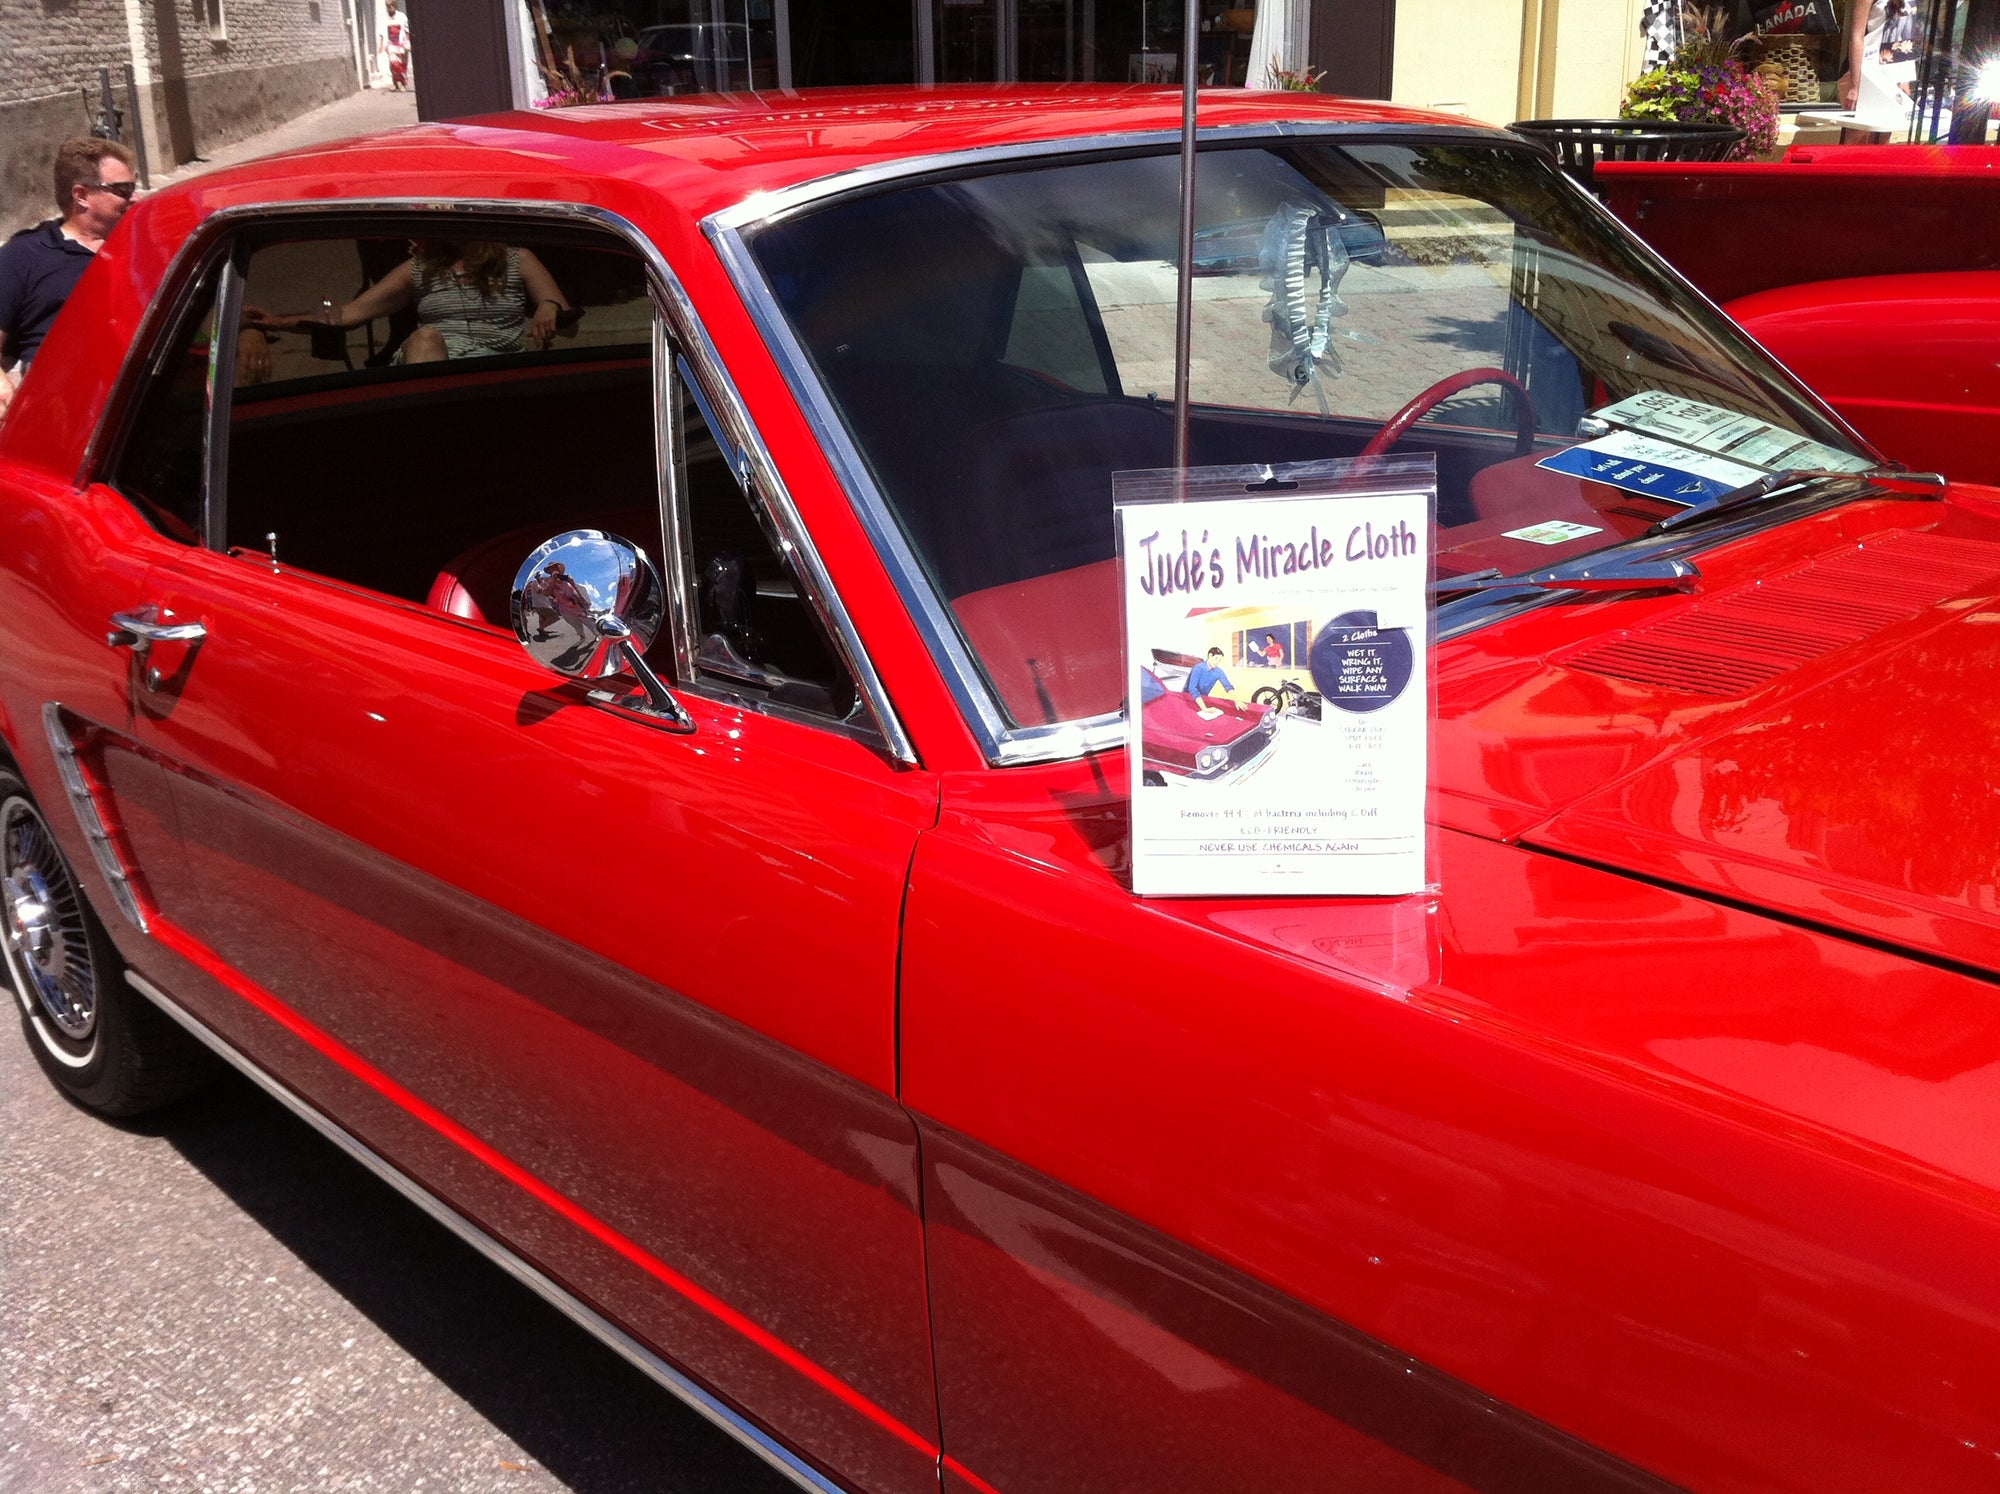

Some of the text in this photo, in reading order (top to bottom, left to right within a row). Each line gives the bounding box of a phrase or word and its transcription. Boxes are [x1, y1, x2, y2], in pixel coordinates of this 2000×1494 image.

[1757, 2, 1817, 34] CANADA
[1635, 394, 1680, 411] 1965
[1666, 403, 1712, 420] Ford
[1138, 519, 1417, 597] Jude's Miracle Cloth
[1342, 629, 1378, 642] 2 Cloths
[1346, 649, 1366, 657] WET
[1341, 658, 1371, 666] WRING
[1341, 666, 1383, 675] WIPE ANY
[1338, 675, 1378, 684] SURFACE
[1338, 683, 1387, 693] WALK AWAY
[1265, 807, 1303, 819] bacteria
[1304, 807, 1348, 821] including
[1199, 842, 1359, 852] NEVER USE CHEMICALS AGAIN
